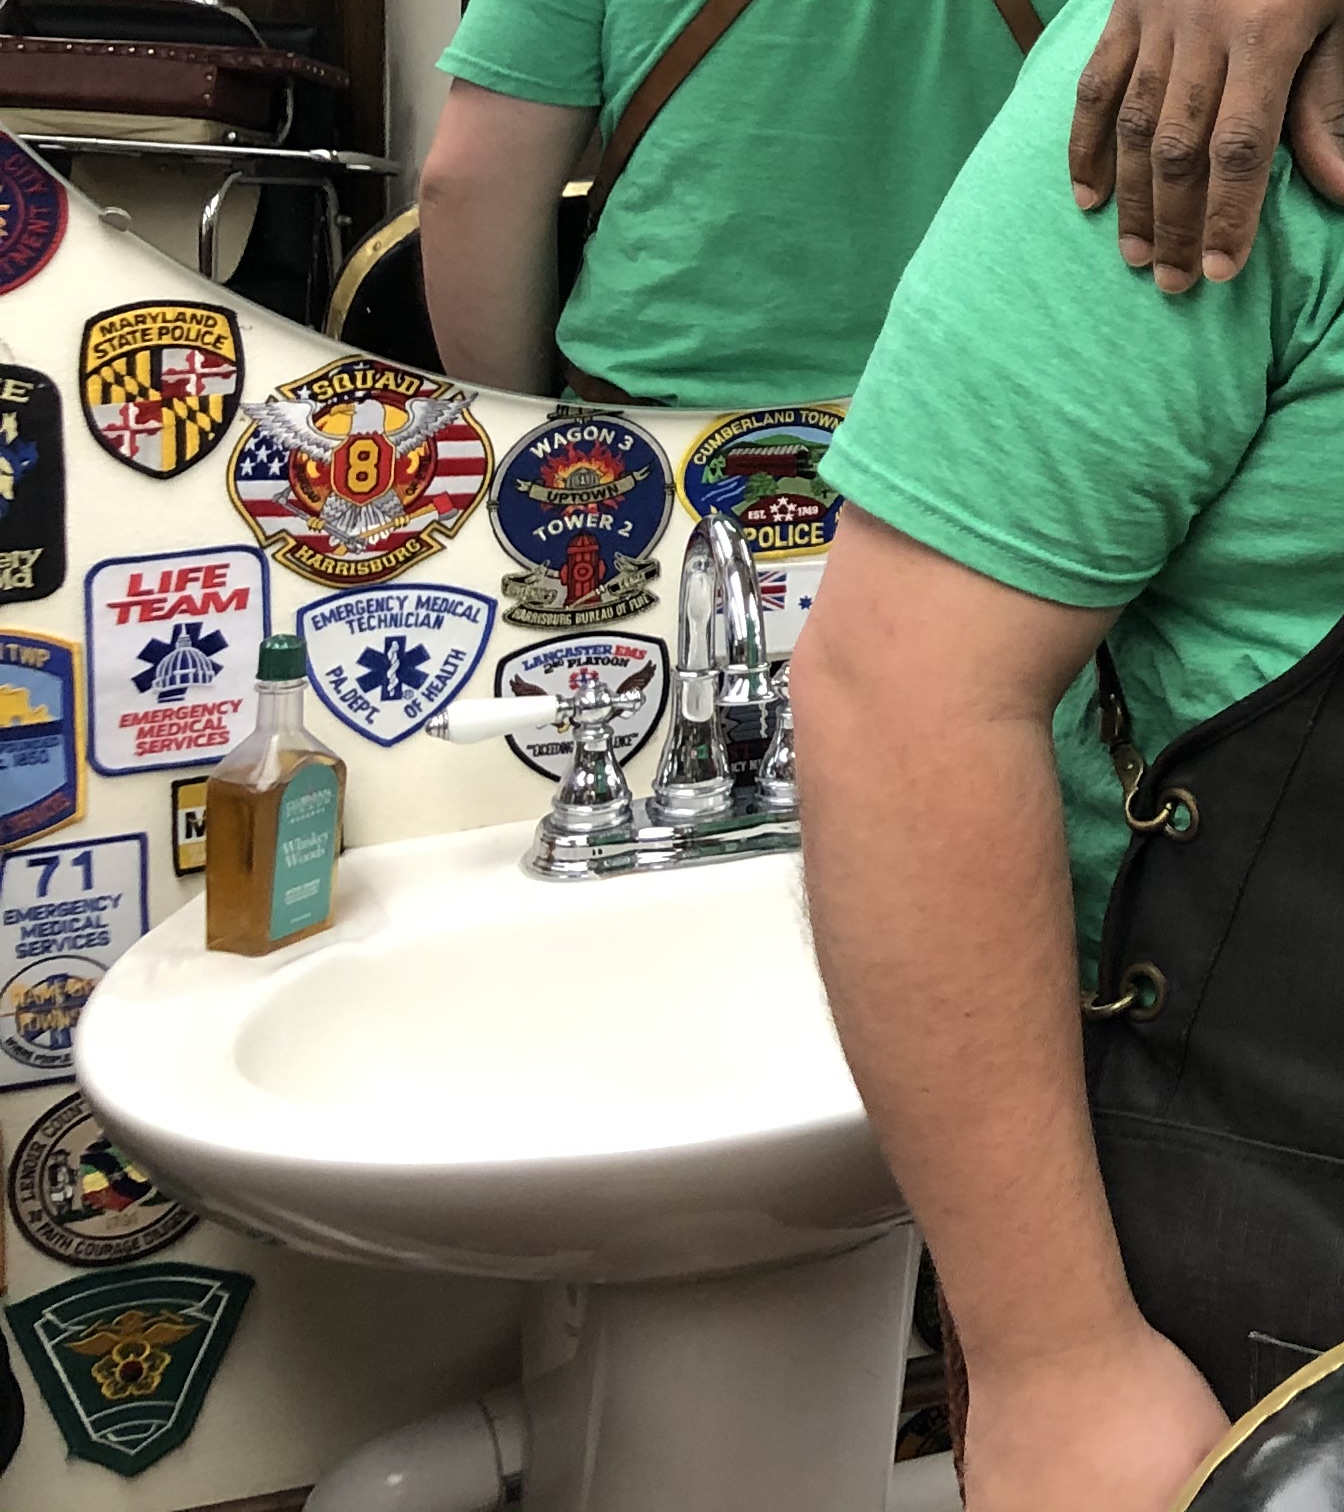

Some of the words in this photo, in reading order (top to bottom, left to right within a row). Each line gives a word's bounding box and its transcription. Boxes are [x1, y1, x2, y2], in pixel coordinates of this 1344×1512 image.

[100, 312, 217, 337] MARYLAND
[93, 327, 153, 359] STATE
[158, 326, 229, 350] POLICE
[313, 370, 423, 401] SQUAD
[530, 425, 616, 459] WAGON
[618, 435, 635, 451] 3
[693, 410, 795, 465] CUMBERLAND
[347, 439, 380, 494] 8
[547, 484, 619, 504] UPTOWN
[533, 512, 615, 542] TOWER
[618, 520, 634, 538] 2
[742, 522, 825, 548] POLICE
[294, 538, 421, 576] HARRISBURG
[126, 562, 230, 598] LIFE
[106, 587, 250, 625] TEAM
[311, 595, 409, 631] EMERGENCY
[415, 594, 482, 624] MEDICAL
[512, 607, 572, 626] HARRISBURG
[575, 606, 614, 624] BUREAU
[616, 602, 628, 615] OF
[346, 611, 445, 635] TECHNICIAN
[6, 643, 51, 668] TWP
[522, 645, 613, 672] LANCASTER
[614, 644, 648, 660] EMS
[567, 656, 631, 669] PLATOON
[325, 665, 348, 695] PA.
[339, 688, 381, 725] DEPT.
[404, 698, 424, 719] OF
[421, 648, 467, 703] HEALTH
[118, 698, 243, 728] EMERGENCY
[136, 716, 227, 741] MEDICAL
[134, 731, 231, 757] SERVICES
[26, 850, 94, 898] 71
[3, 892, 123, 925] EMERGENCY
[20, 916, 109, 940] MEDICAL
[15, 930, 111, 959] SERVICES
[21, 1140, 48, 1203] LENOIR
[37, 1223, 73, 1250] FAITH
[74, 1238, 141, 1257] COURAGE
